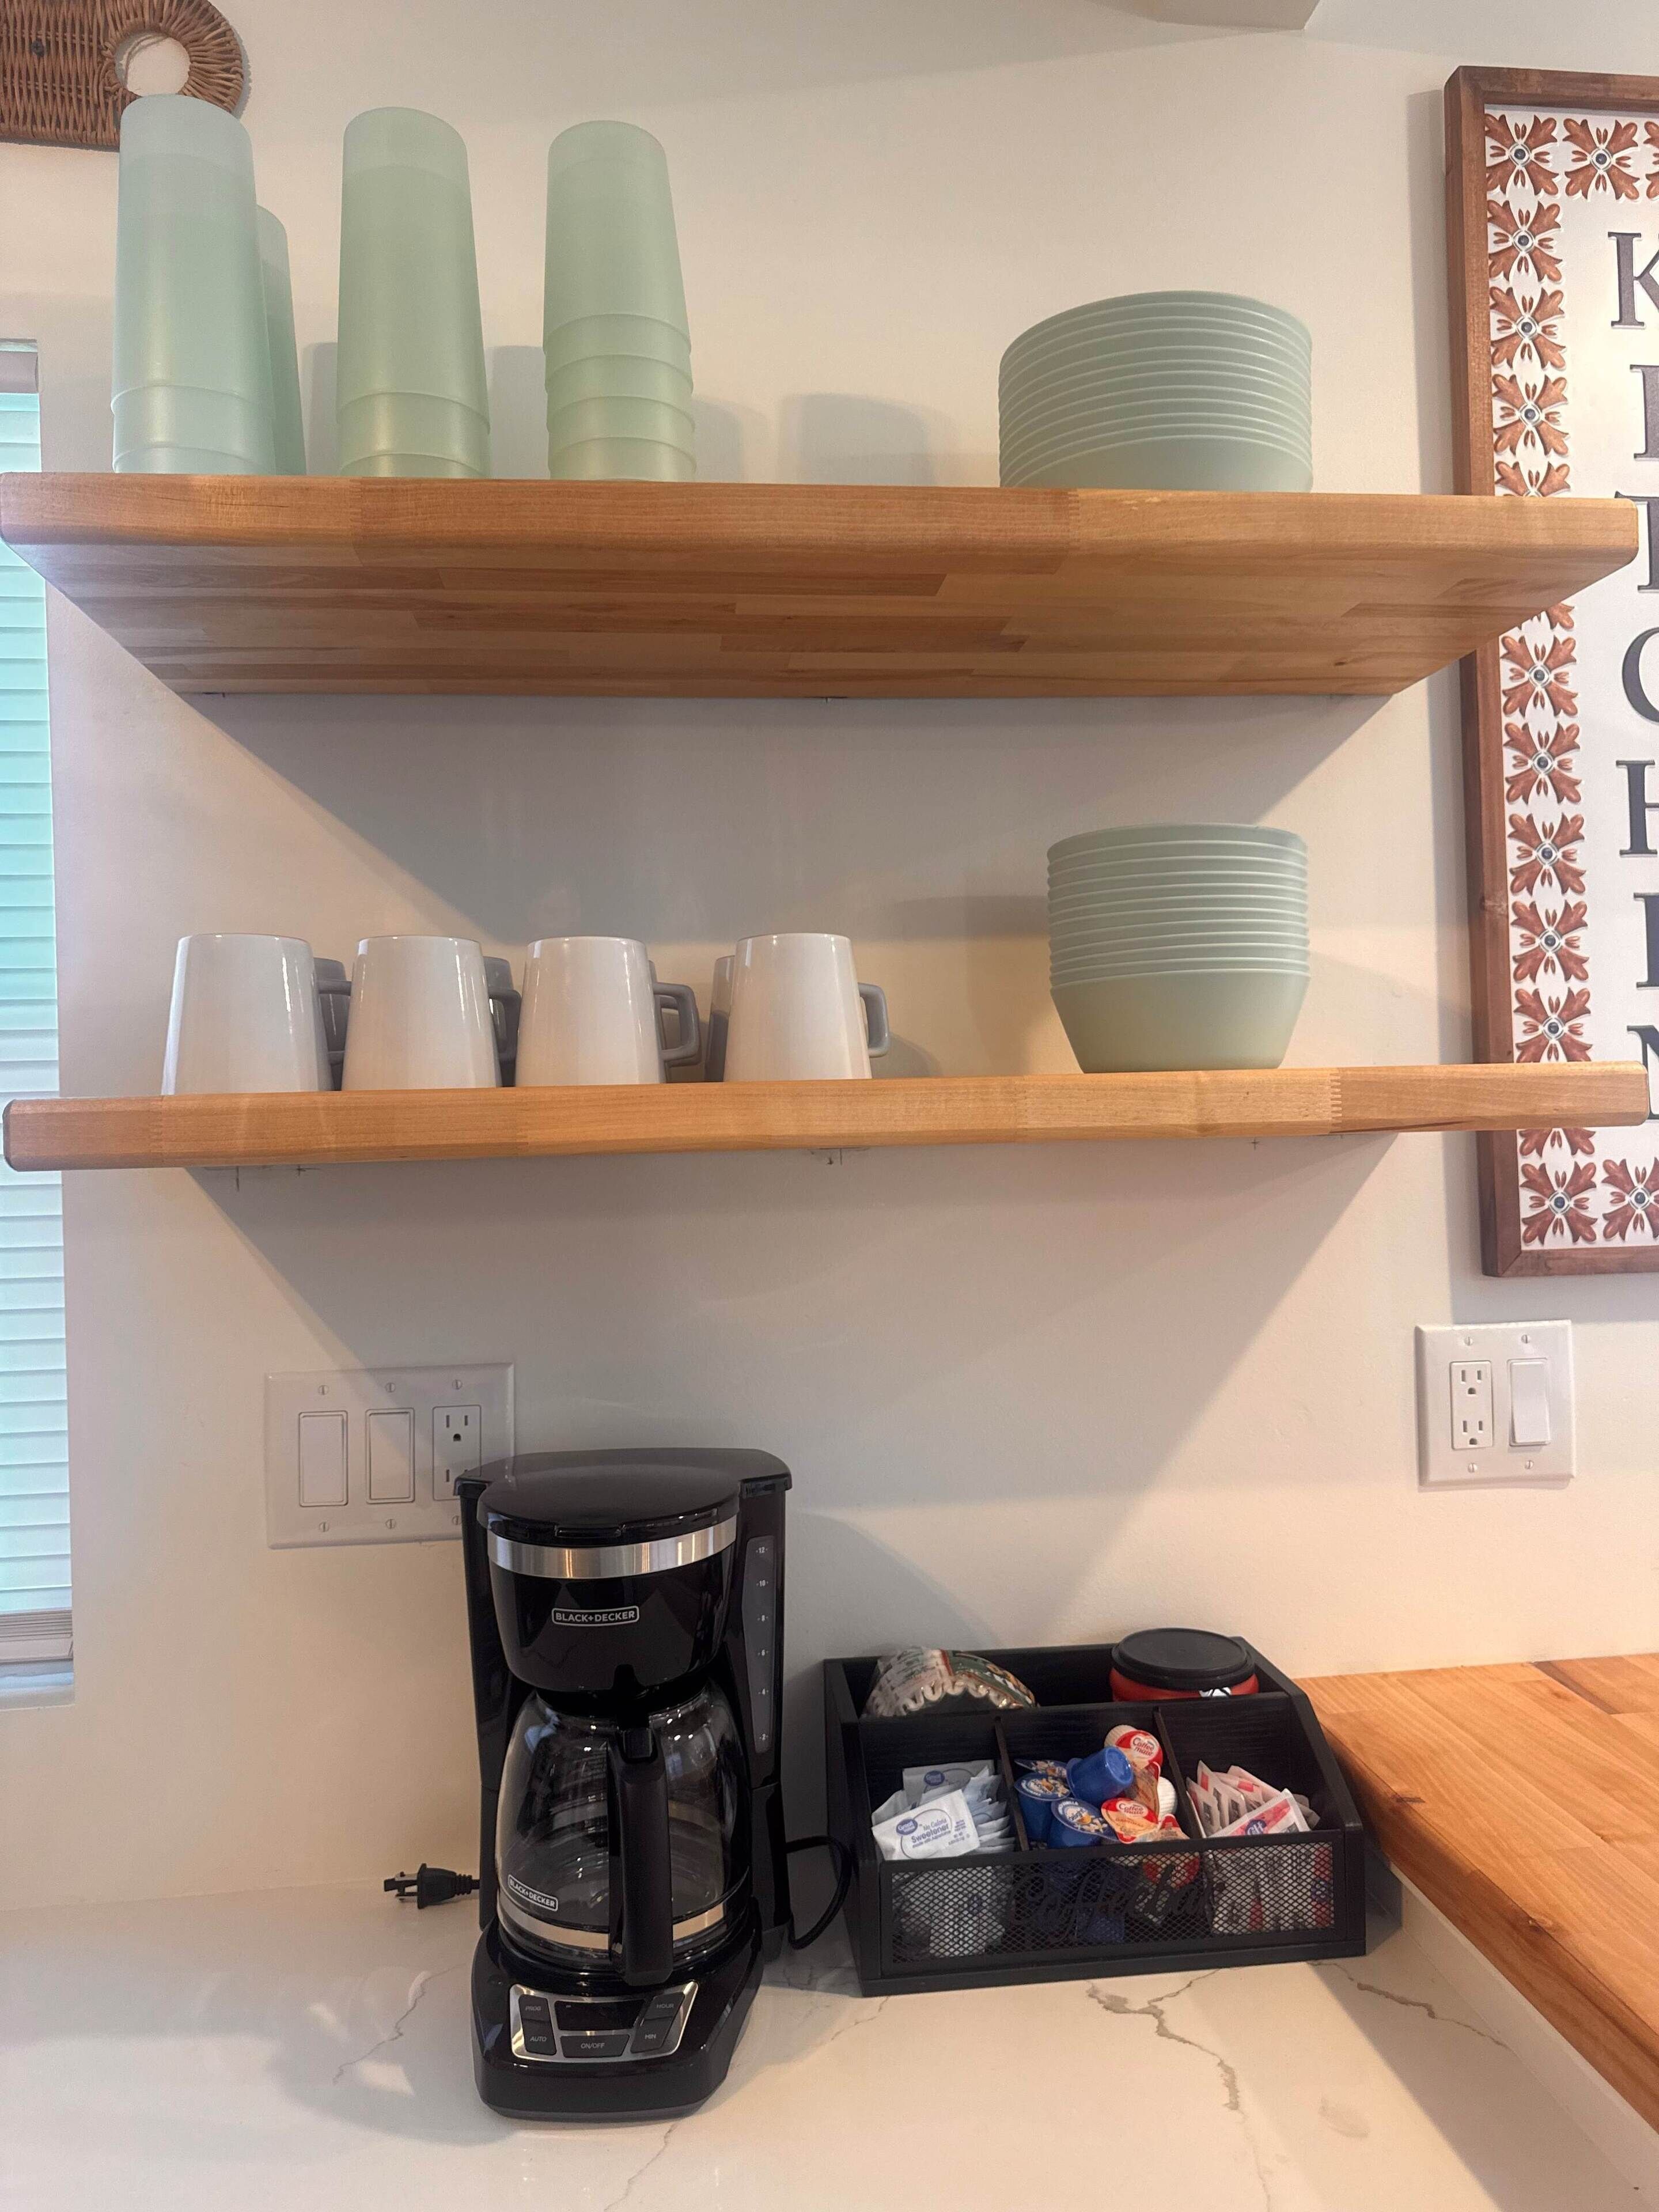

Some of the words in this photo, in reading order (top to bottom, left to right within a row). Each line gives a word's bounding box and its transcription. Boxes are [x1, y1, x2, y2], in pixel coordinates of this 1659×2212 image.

[555, 1611, 635, 1623] BLACK+DECKER
[1132, 1737, 1155, 1751] Coffee
[911, 1823, 949, 1843] Sweetener
[509, 1878, 555, 1908] BLACK+DECKER
